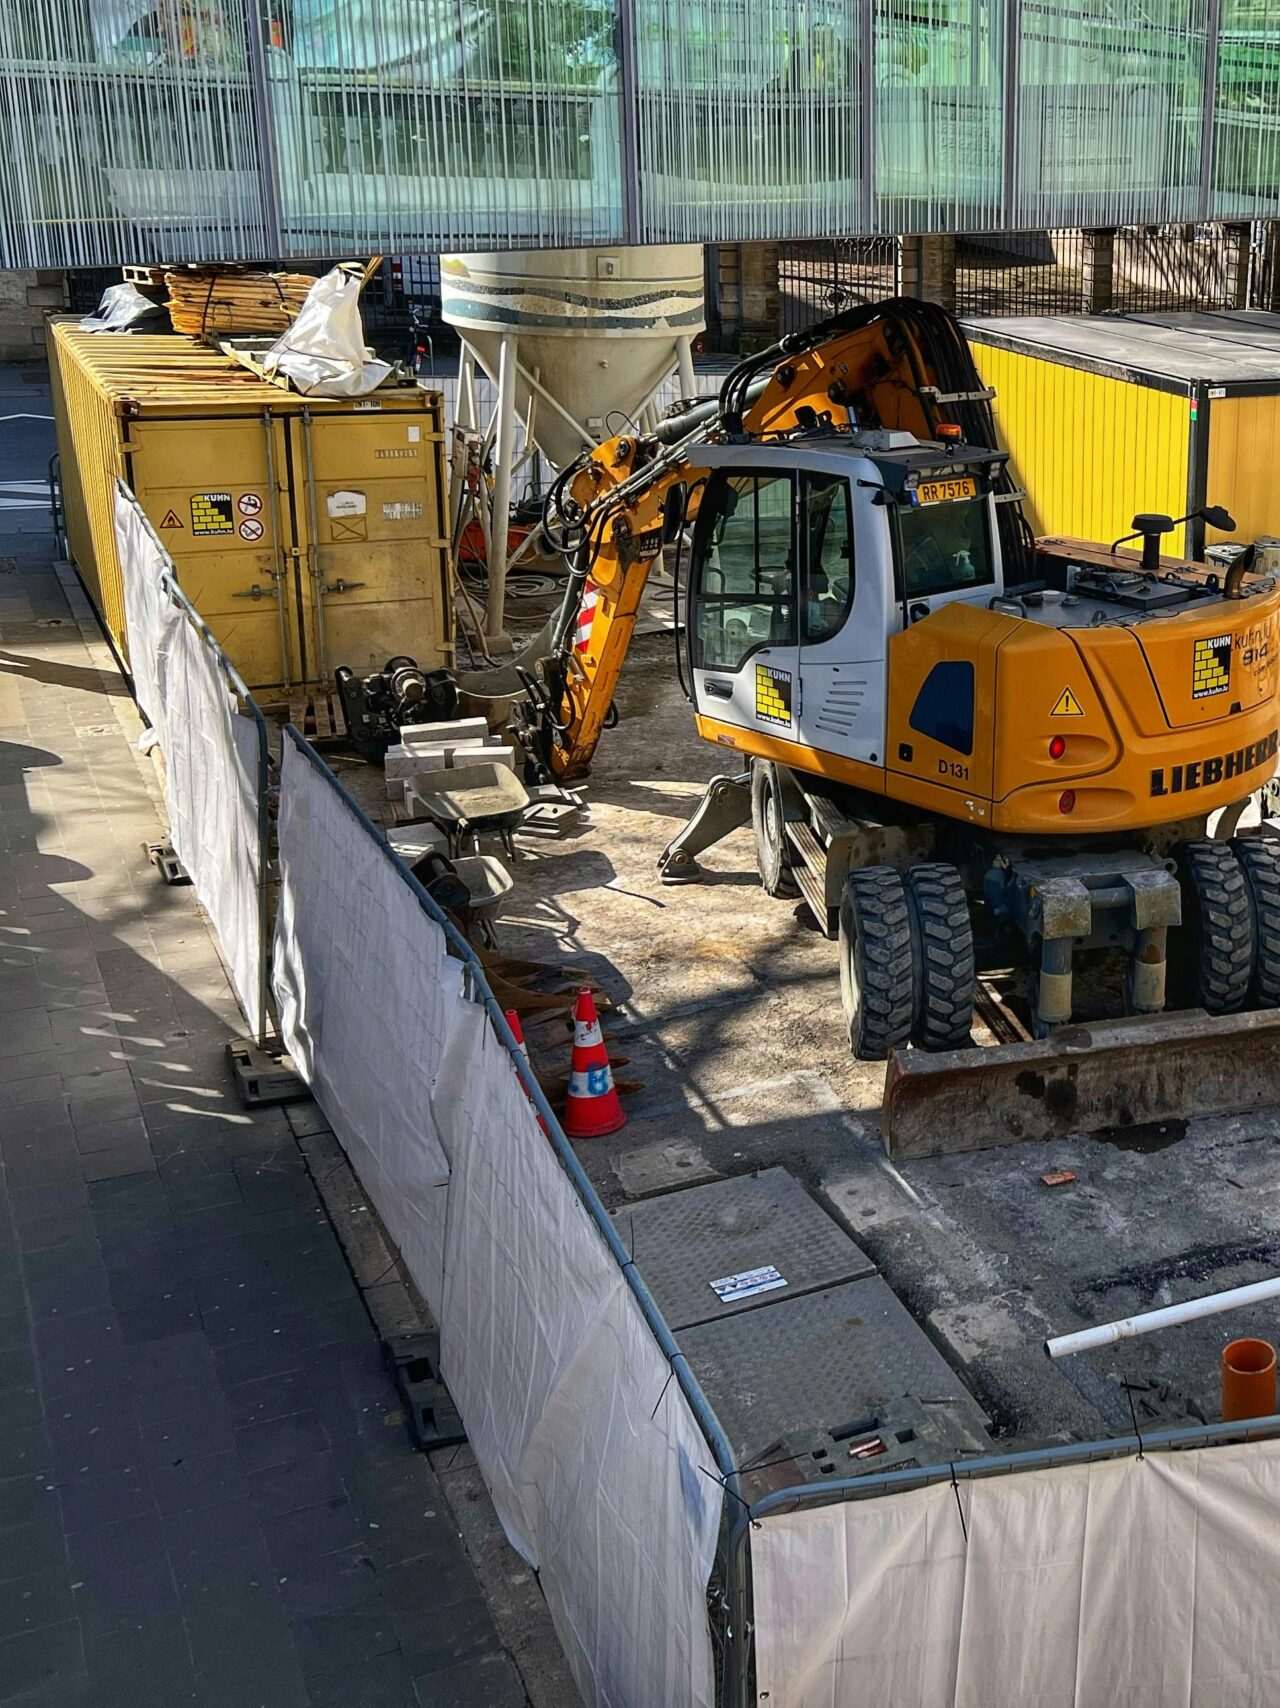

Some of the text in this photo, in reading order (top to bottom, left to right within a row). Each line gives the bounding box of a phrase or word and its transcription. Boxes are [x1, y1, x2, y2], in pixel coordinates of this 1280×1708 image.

[203, 494, 231, 502] KUHN
[922, 480, 970, 501] RR 7576
[1208, 635, 1232, 650] KUHN
[1243, 642, 1269, 667] 914
[767, 668, 791, 684] KUHN
[1150, 729, 1279, 798] LIEBHERR
